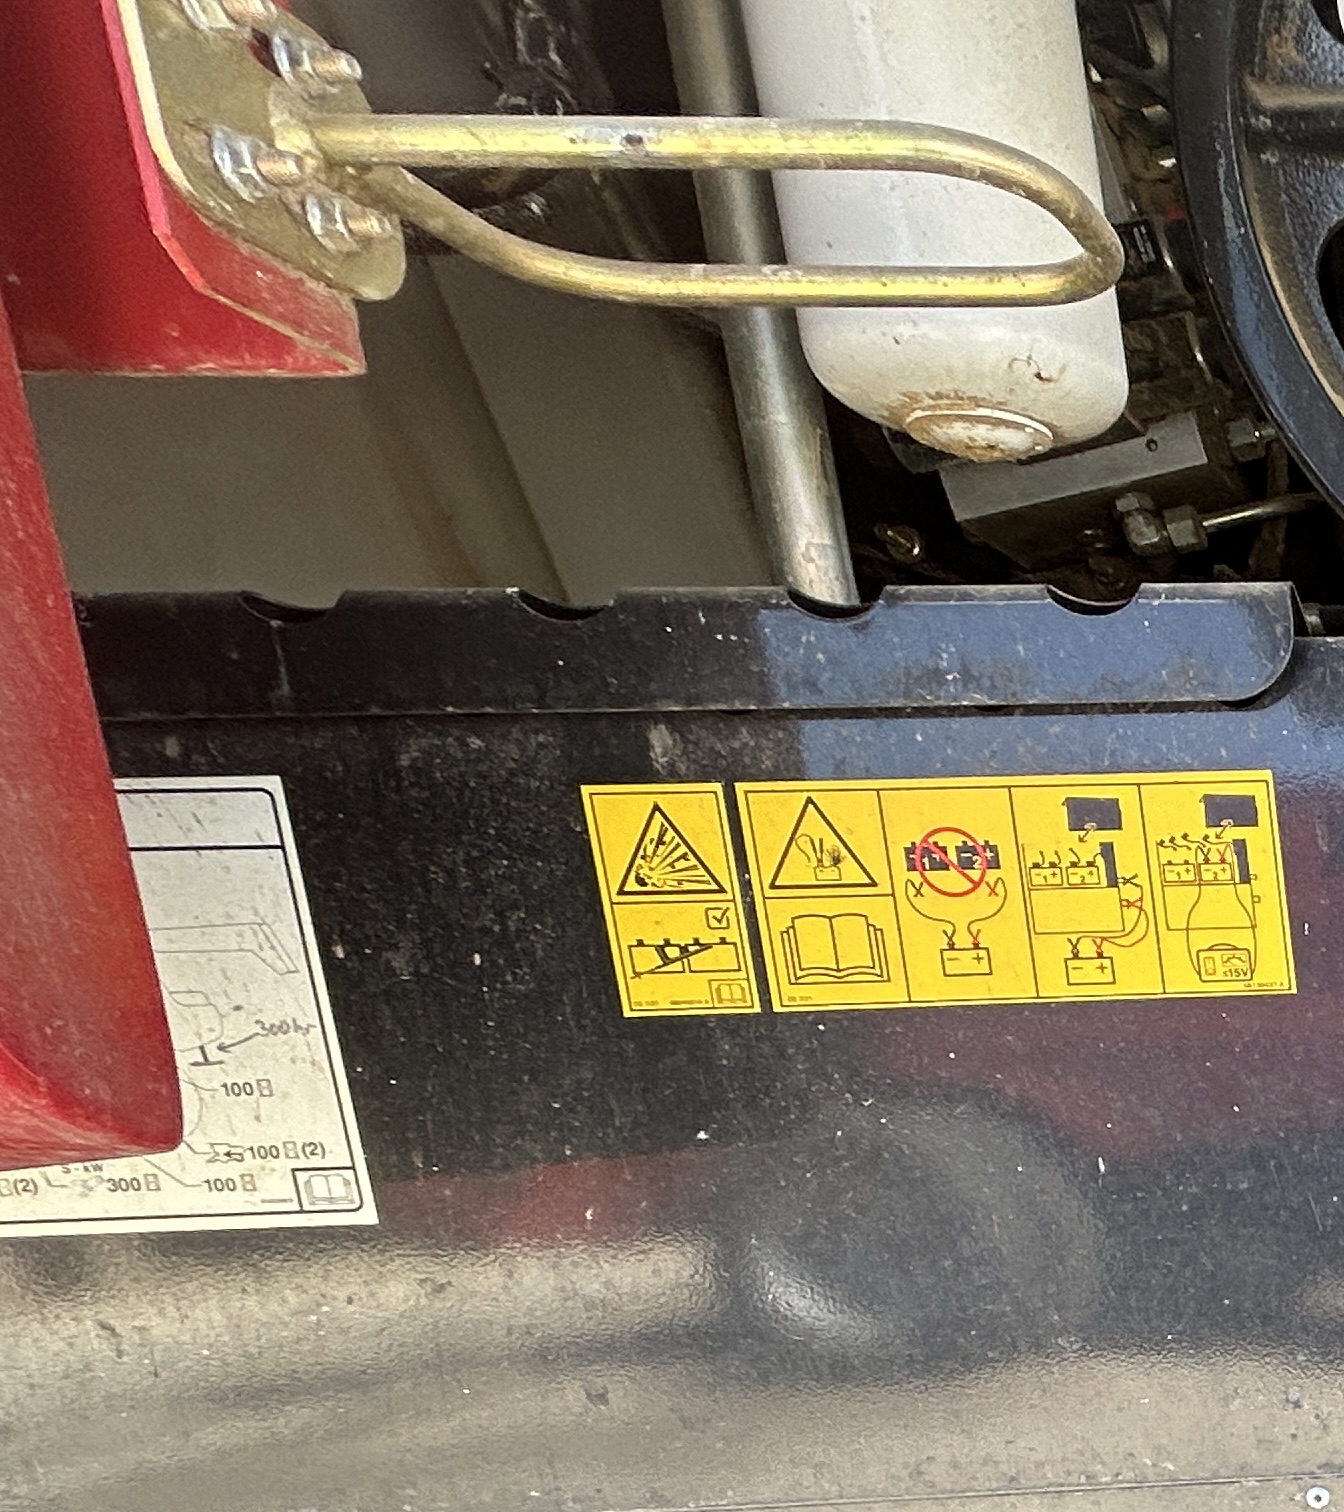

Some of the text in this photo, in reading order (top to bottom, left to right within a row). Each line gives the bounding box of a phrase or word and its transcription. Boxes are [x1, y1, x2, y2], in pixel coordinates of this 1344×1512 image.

[220, 1081, 254, 1097] 100
[249, 1141, 327, 1160] 100 (2)
[13, 1177, 39, 1196] (2)
[106, 1177, 142, 1193] 300
[203, 1177, 237, 1193] 100
